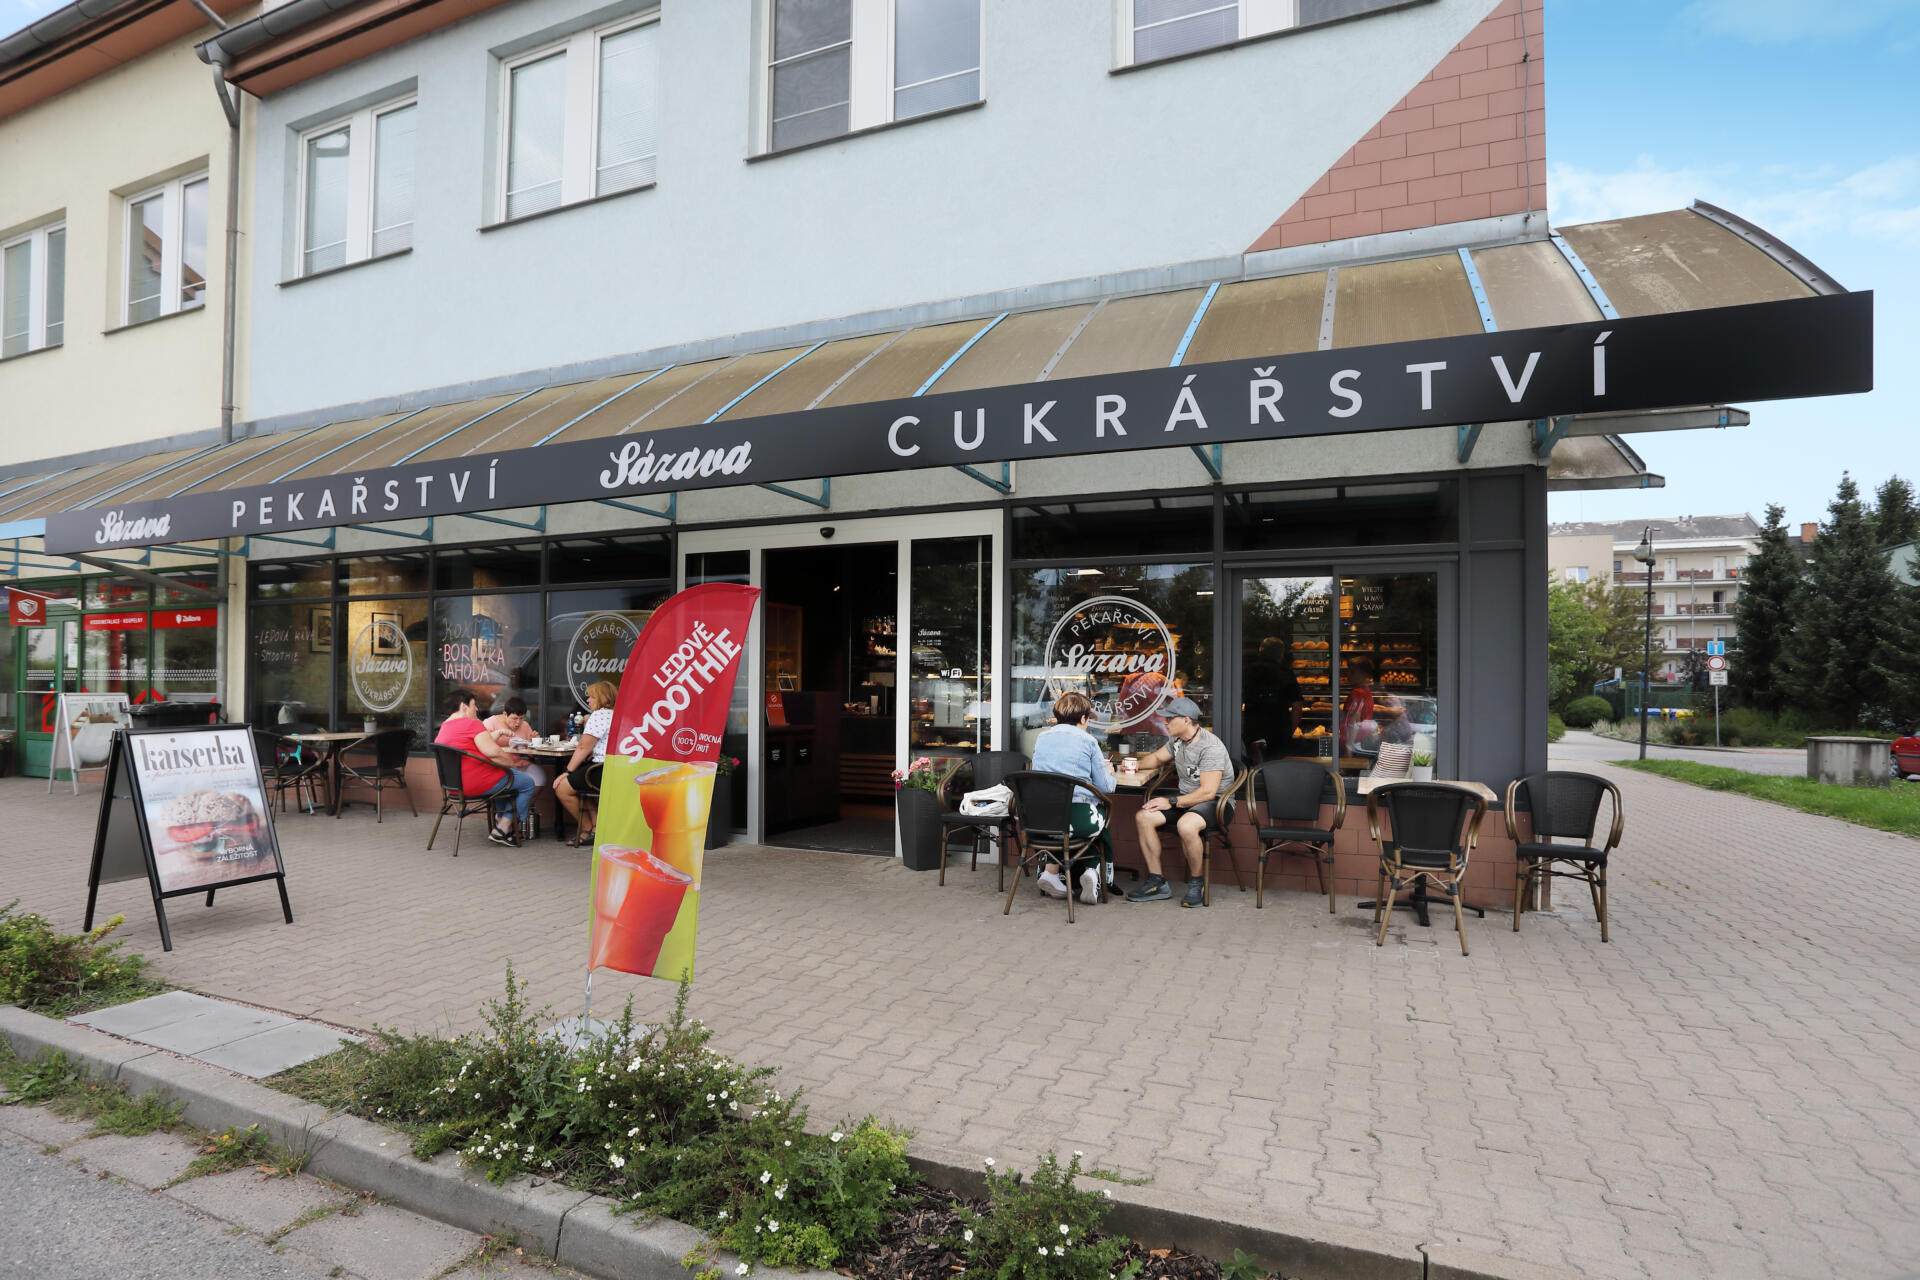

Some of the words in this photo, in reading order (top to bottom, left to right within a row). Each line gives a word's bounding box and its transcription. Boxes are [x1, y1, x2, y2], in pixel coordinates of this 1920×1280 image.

[95, 509, 171, 545] Sázava
[231, 459, 499, 528] PEKAŘSTVÍ
[600, 438, 752, 489] Sázava
[887, 331, 1608, 457] CUKRÁŘSTVÍ
[1070, 608, 1157, 641] PEKAŘSTVÍ
[356, 654, 407, 674] Sázava
[572, 650, 628, 673] Sázav
[652, 620, 715, 689] LEDOVÉ
[1053, 643, 1166, 673] Sázava
[618, 627, 742, 765] SMOOTHIE
[139, 735, 245, 771] kaiserka
[677, 736, 694, 746] 100%
